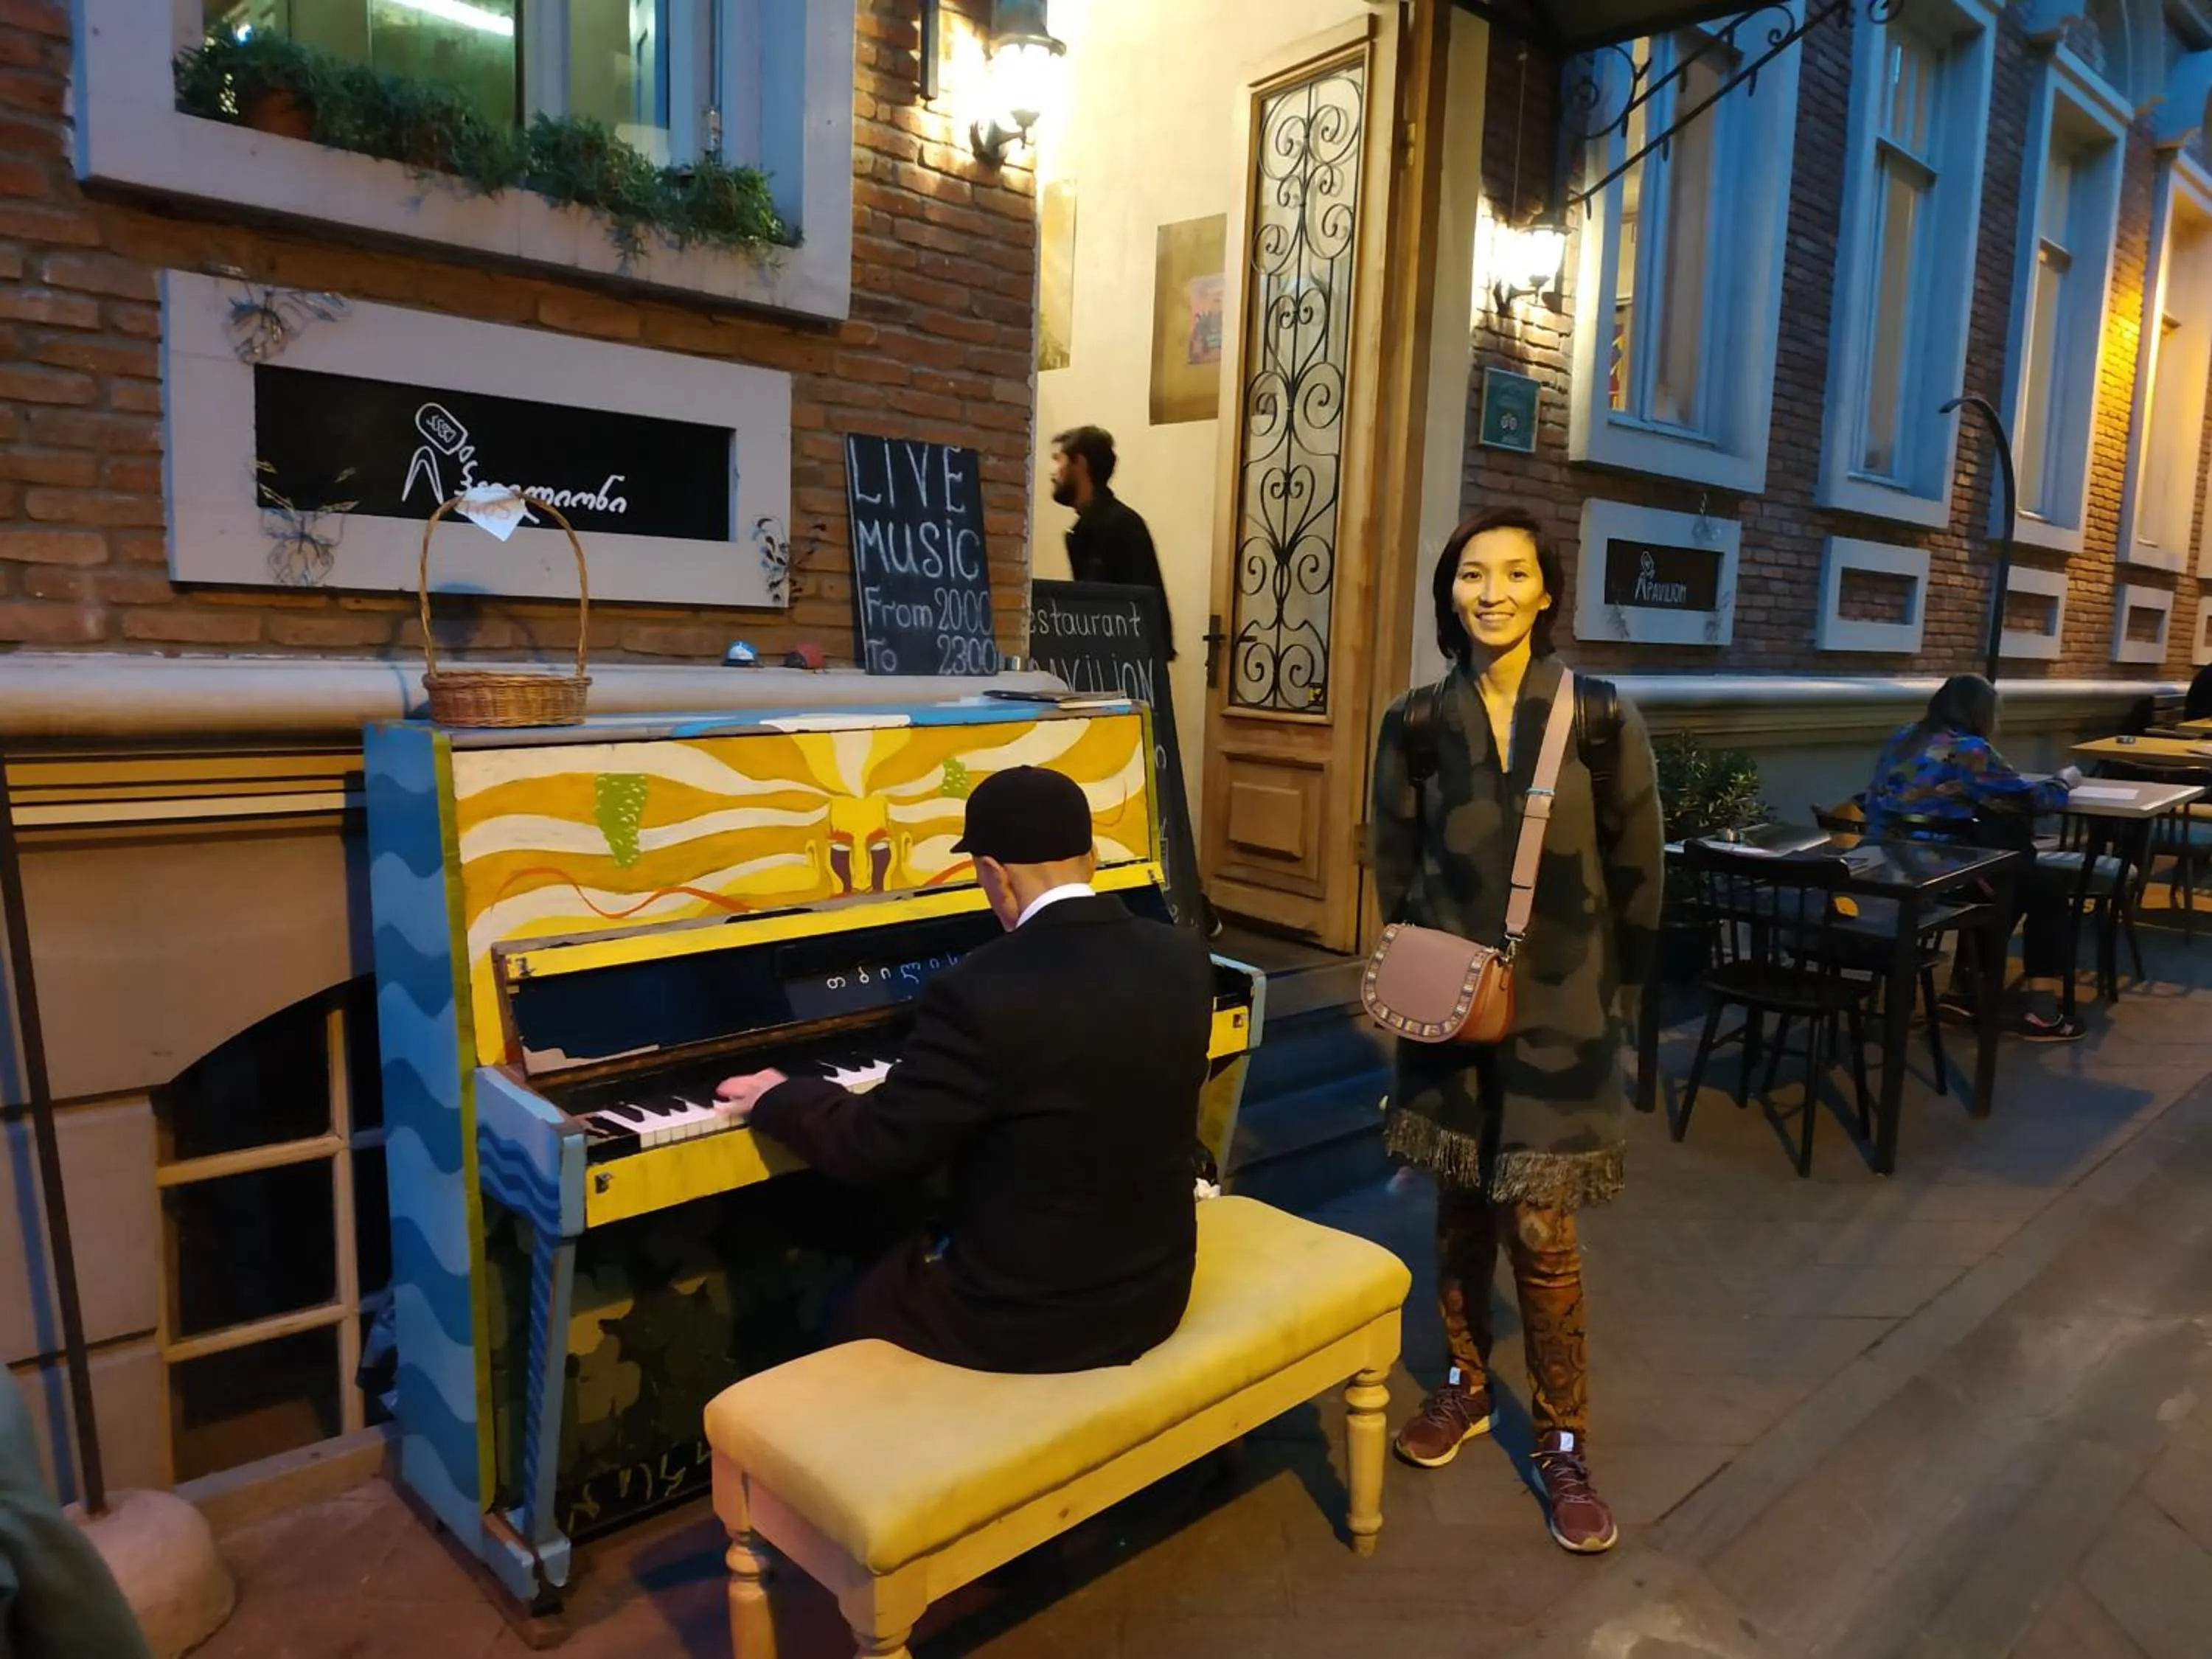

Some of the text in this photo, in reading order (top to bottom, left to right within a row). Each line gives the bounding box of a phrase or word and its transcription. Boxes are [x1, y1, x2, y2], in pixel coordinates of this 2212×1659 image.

[849, 435, 966, 513] LIVE
[858, 518, 980, 581] MUSIC
[865, 585, 993, 636] From 2000
[867, 633, 996, 675] To 2300
[826, 951, 959, 990] თბილის
